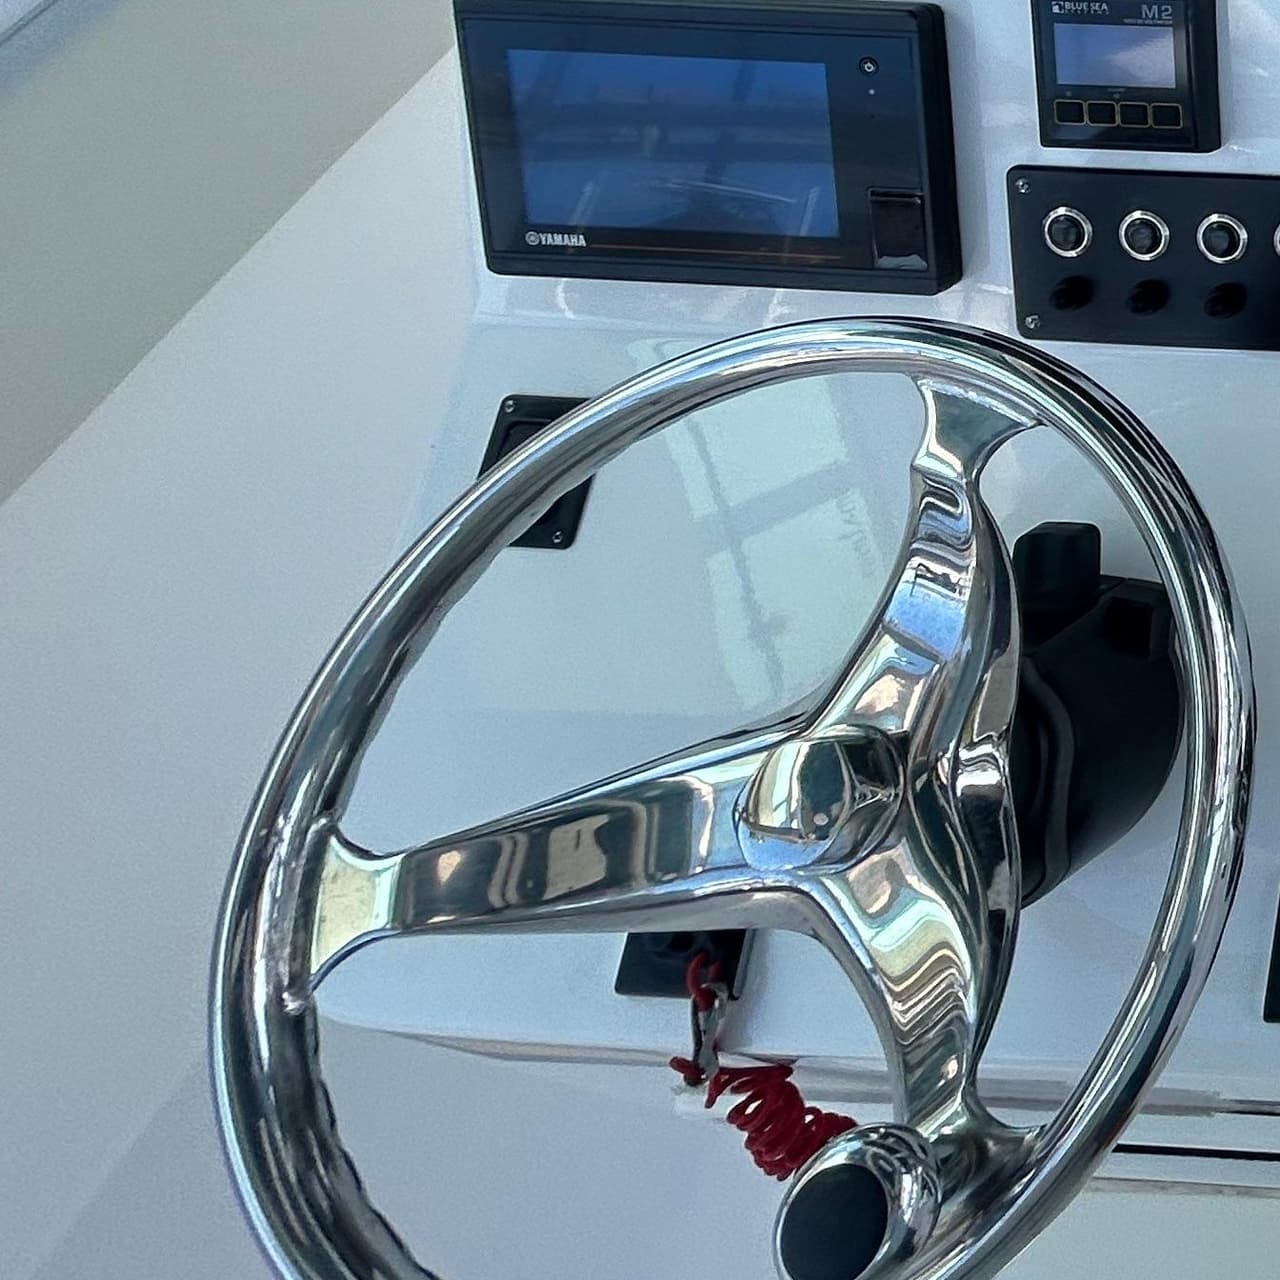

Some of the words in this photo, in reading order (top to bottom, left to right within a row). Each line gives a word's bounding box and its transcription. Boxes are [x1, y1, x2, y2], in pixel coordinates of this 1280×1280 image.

[1064, 1, 1089, 10] BLUE
[1090, 2, 1109, 11] SEA
[1141, 4, 1173, 19] M2
[539, 232, 587, 247] YAMAHA
